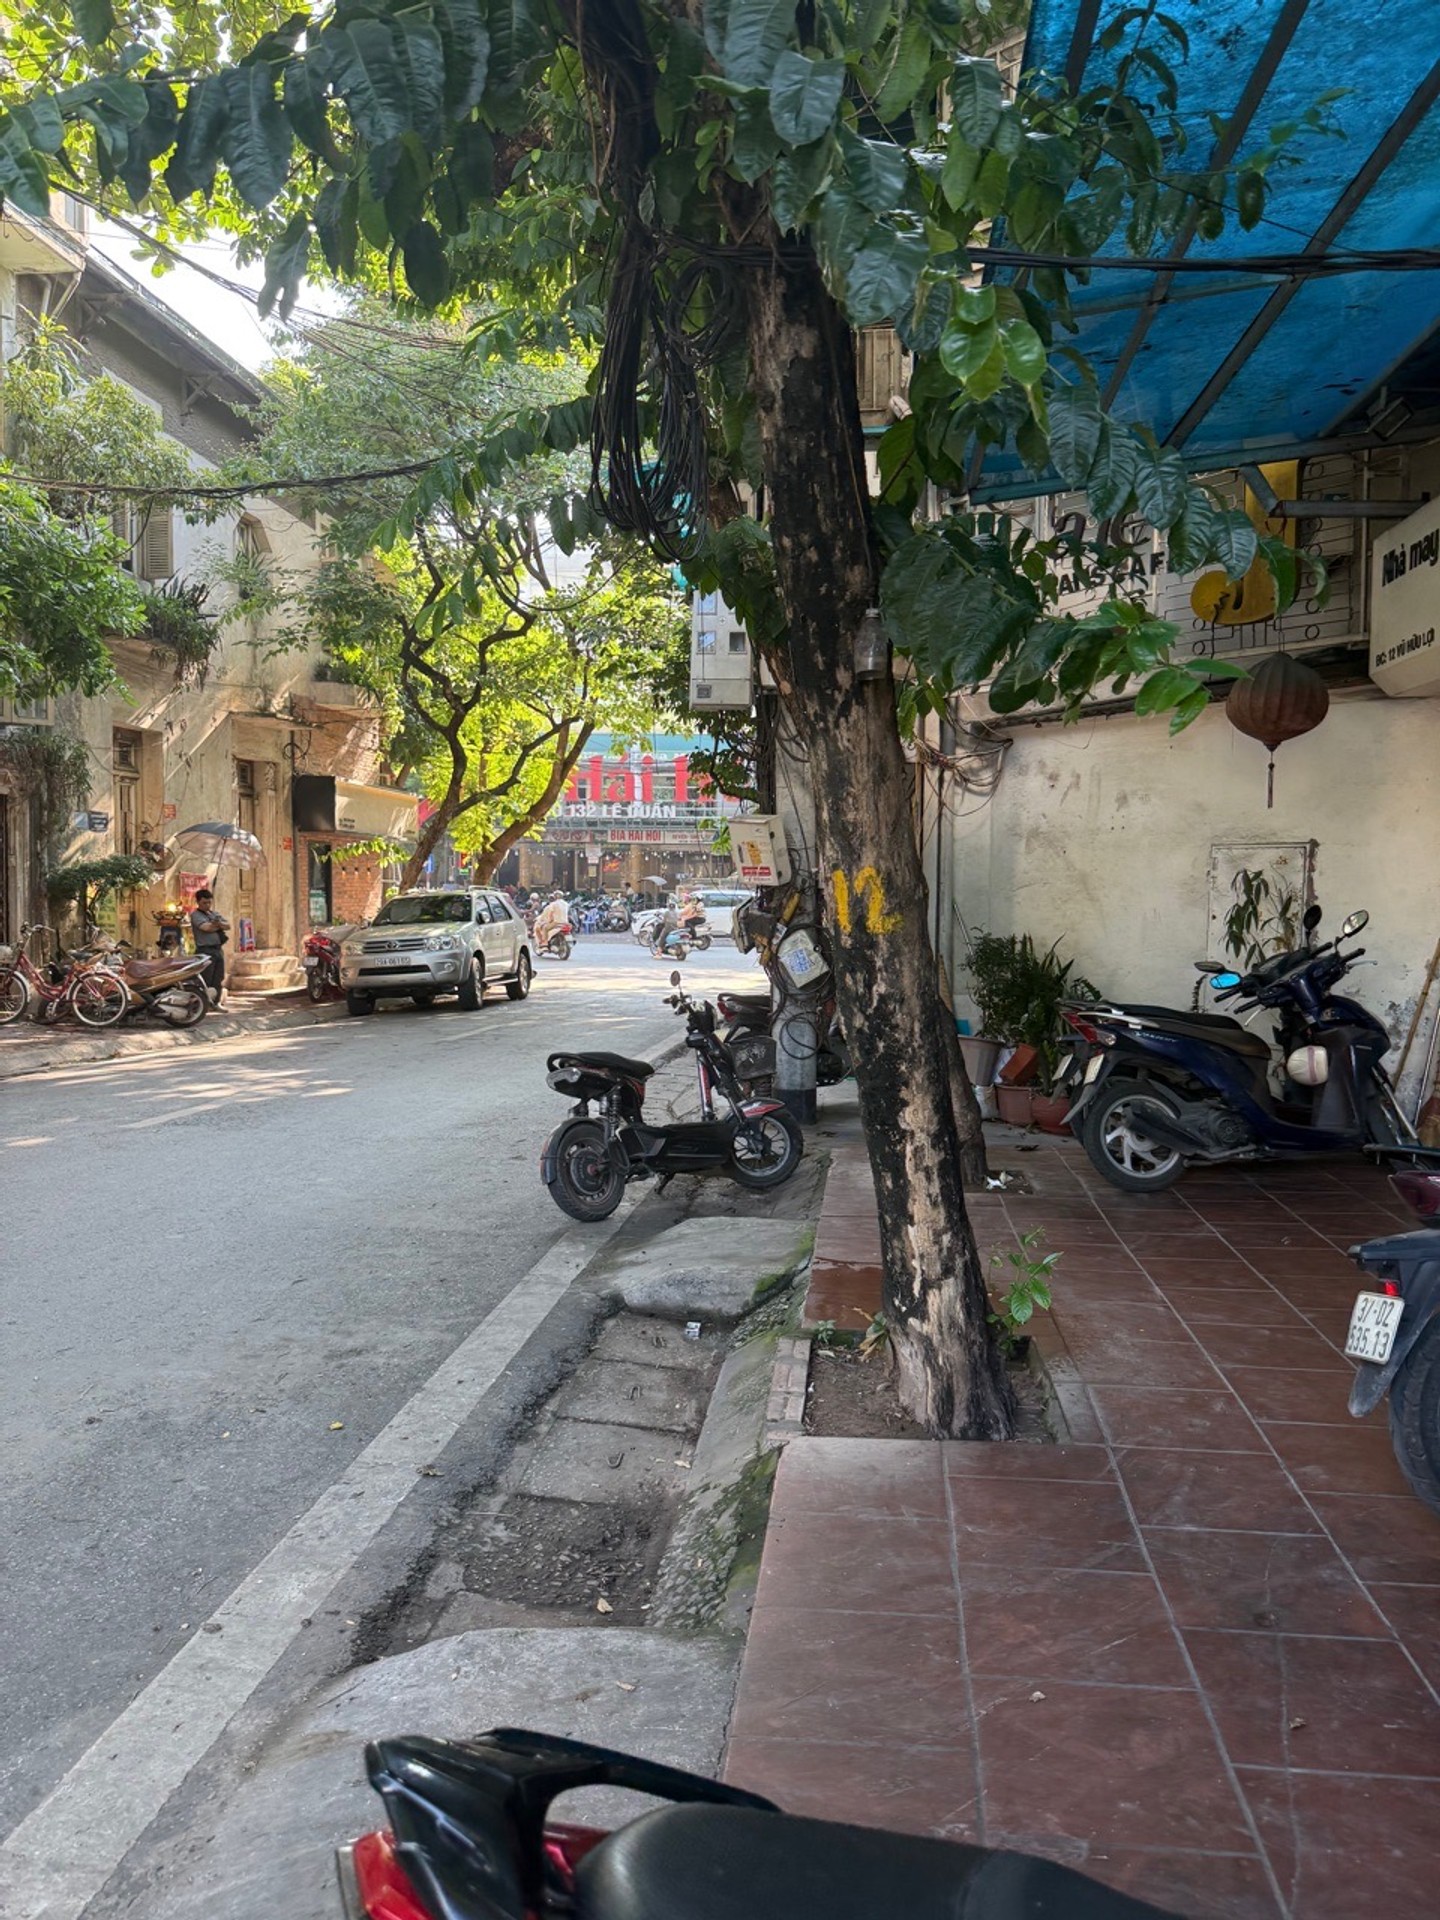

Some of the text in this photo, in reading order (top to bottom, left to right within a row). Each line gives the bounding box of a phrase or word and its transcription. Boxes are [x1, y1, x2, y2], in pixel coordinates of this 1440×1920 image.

[1382, 528, 1440, 587] Nhà may
[1388, 647, 1396, 661] 12
[567, 804, 597, 818] 132
[602, 803, 622, 818] LÊ
[610, 829, 626, 841] BIA
